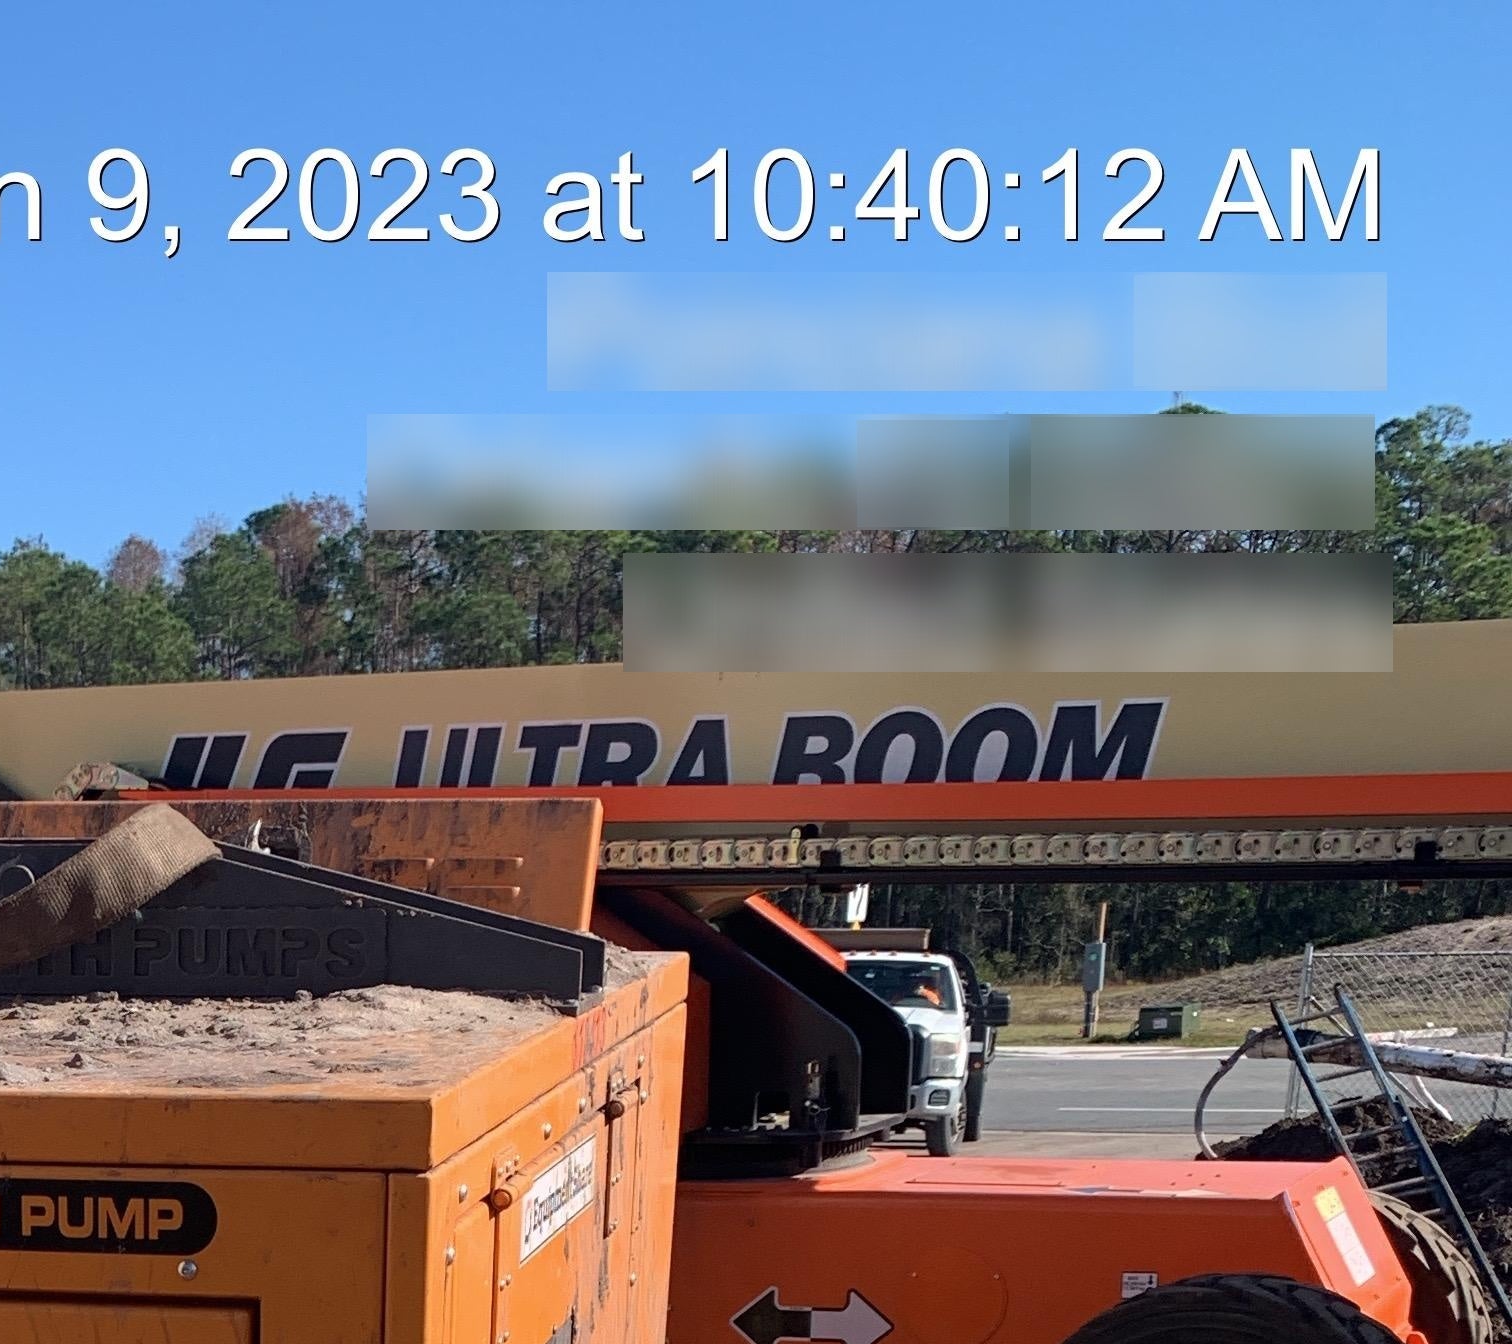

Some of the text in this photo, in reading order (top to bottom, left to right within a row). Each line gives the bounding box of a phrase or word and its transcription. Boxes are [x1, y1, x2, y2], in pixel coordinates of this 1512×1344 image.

[393, 714, 729, 788] ULTRA
[774, 697, 1170, 785] BOOM
[132, 927, 368, 979] PUMPS
[20, 1192, 184, 1242] PUMP
